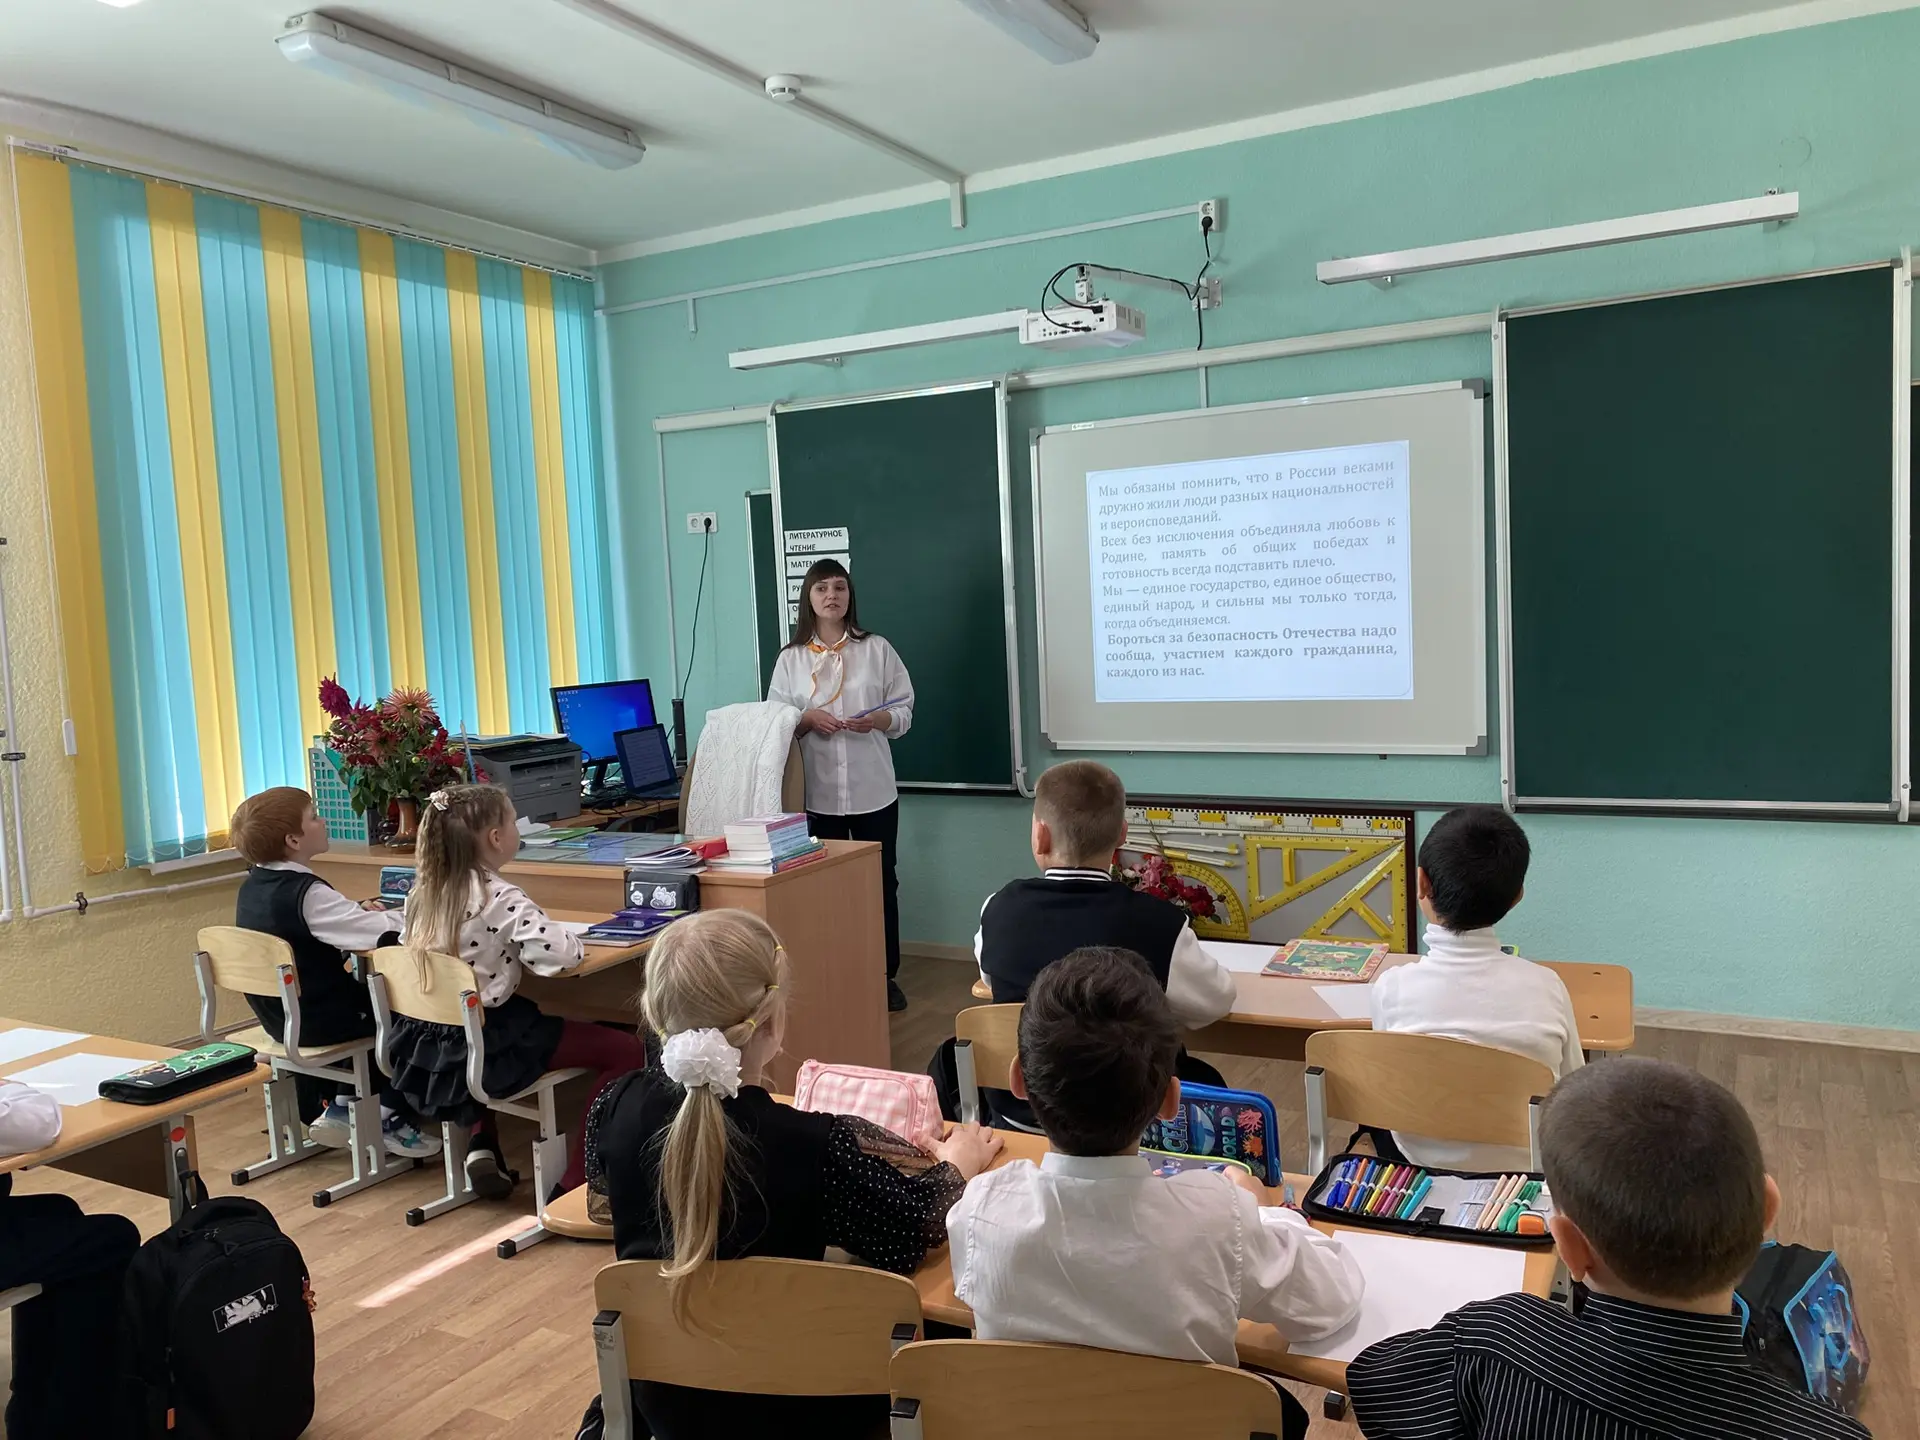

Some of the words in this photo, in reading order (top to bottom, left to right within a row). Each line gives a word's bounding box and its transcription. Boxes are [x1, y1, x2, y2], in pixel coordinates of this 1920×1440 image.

[1099, 485, 1118, 497] Мы
[1124, 481, 1175, 494] обязаны
[1182, 477, 1240, 489] помнить,
[1246, 472, 1269, 484] что
[1276, 472, 1282, 481] в
[1289, 466, 1336, 479] России
[1344, 460, 1394, 475] веками
[1099, 502, 1144, 515] дружно
[1147, 499, 1180, 509] жили
[1183, 494, 1217, 508] люди
[1220, 490, 1268, 506] разных
[1272, 477, 1394, 500] национальностей
[1100, 520, 1107, 530] и
[1111, 510, 1221, 530] вероисповеданий.
[789, 529, 843, 540] ЛИТЕРАТУРНОЕ
[1101, 535, 1127, 547] Всех
[1132, 532, 1151, 545] без
[1157, 528, 1234, 543] исключения
[1240, 521, 1321, 536] объединяла
[1327, 517, 1380, 532] любовь
[1388, 516, 1395, 526] к
[789, 543, 816, 552] ЧТЕНИЕ
[1101, 552, 1146, 564] Родине,
[1161, 548, 1206, 560] память
[1222, 544, 1236, 556] об
[1253, 540, 1296, 553] общих
[1313, 535, 1368, 549] победах
[1387, 535, 1395, 544] и
[1102, 567, 1169, 580] готовность
[1172, 565, 1211, 575] всегда
[1214, 558, 1288, 574] подставить
[1292, 557, 1335, 569] плечо.
[1103, 585, 1123, 596] Мы
[1143, 582, 1186, 595] единое
[1190, 579, 1269, 593] государство,
[1273, 574, 1321, 587] единое
[1325, 573, 1396, 585] общество,
[1103, 600, 1149, 613] единый
[1156, 598, 1194, 611] народ,
[1202, 598, 1209, 608] и
[1216, 595, 1264, 608] сильны
[1272, 594, 1292, 605] мы
[1299, 591, 1347, 604] только
[1354, 591, 1396, 602] тогда,
[1104, 617, 1137, 630] когда
[1139, 615, 1230, 628] объединяемся.
[1108, 634, 1165, 646] Бороться
[1169, 633, 1183, 644] за
[1187, 630, 1278, 641] безопасность
[1283, 627, 1356, 639] Отечества
[1361, 626, 1397, 639] надо
[1106, 650, 1154, 663] сообща,
[1163, 648, 1224, 662] участием
[1235, 647, 1293, 659] каждого
[1303, 645, 1397, 658] гражданина,
[1107, 667, 1158, 679] каждого
[1162, 666, 1177, 677] из
[1180, 666, 1204, 677] нас.
[1141, 810, 1146, 819] 1
[1167, 811, 1172, 820] 2
[1193, 812, 1199, 821] 3
[1220, 813, 1226, 823] 4
[1276, 816, 1283, 825] 6
[1305, 817, 1311, 826] 7
[1335, 818, 1341, 827] 8
[1365, 819, 1371, 829] 9
[1391, 820, 1402, 830] 10
